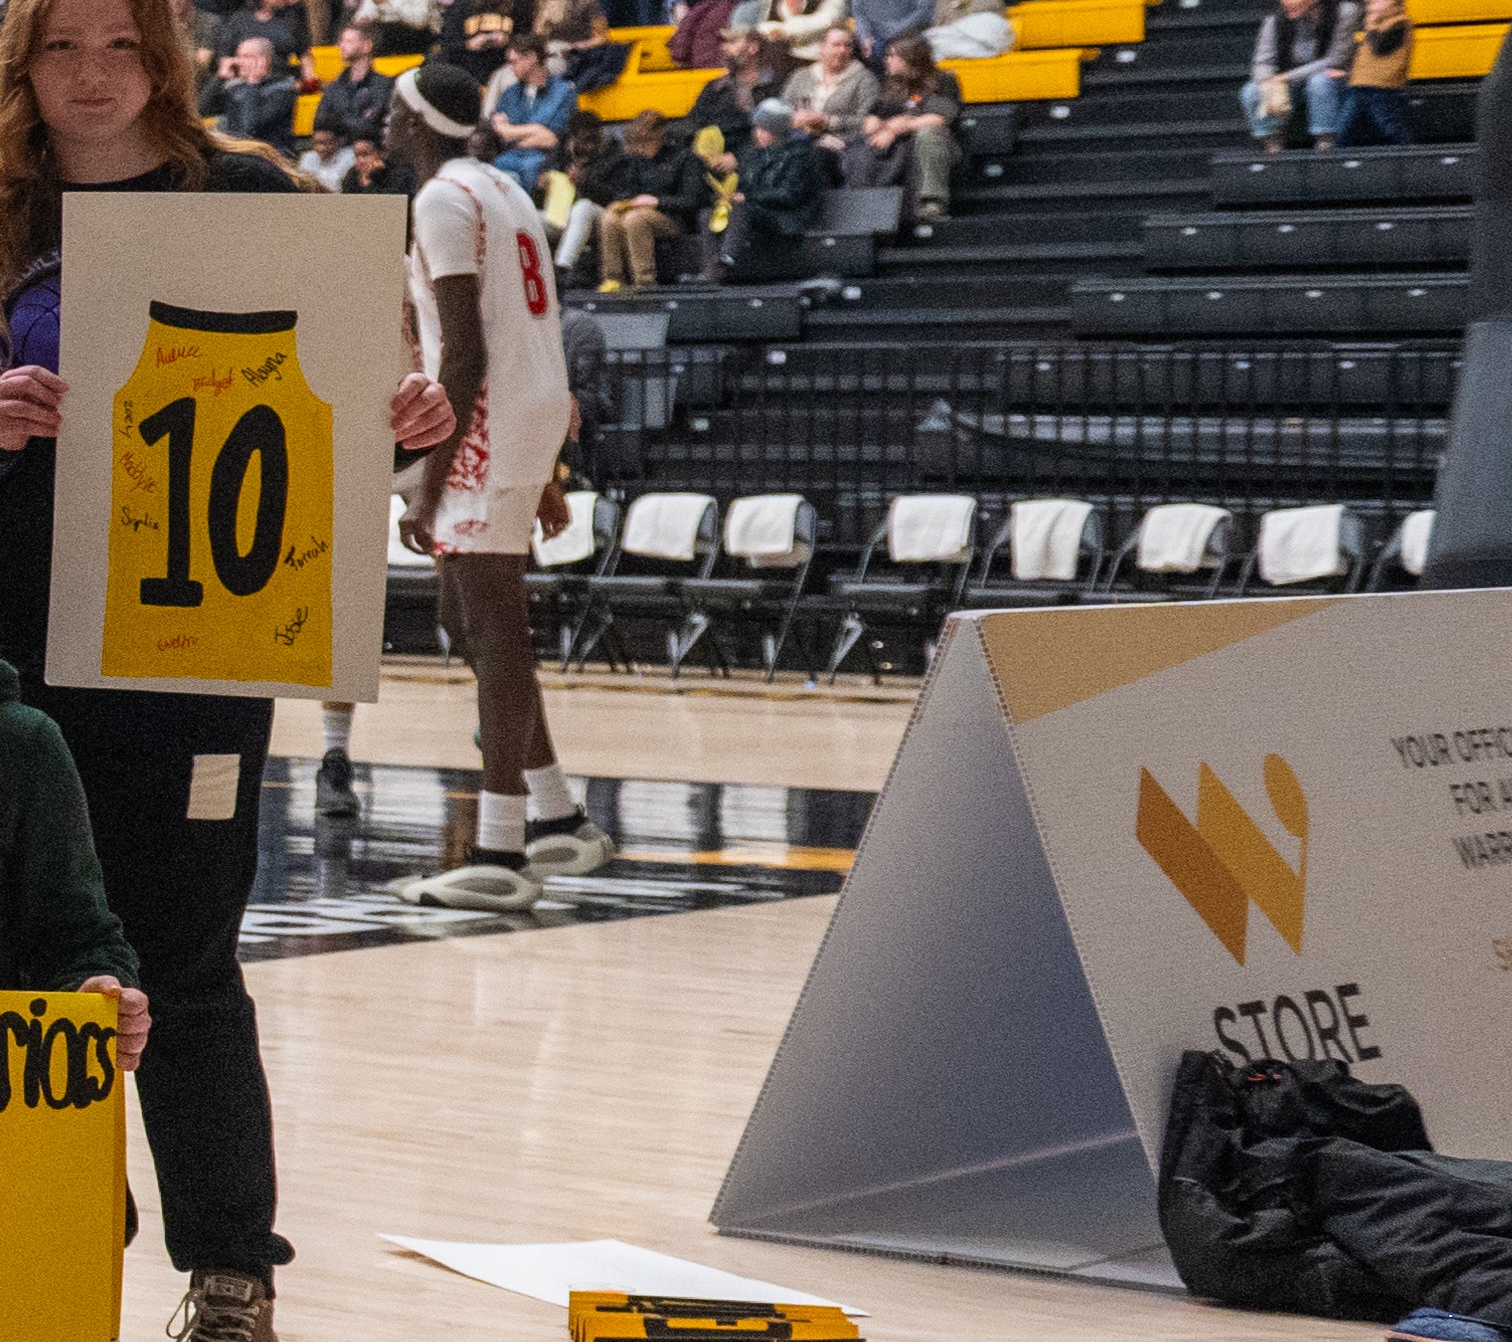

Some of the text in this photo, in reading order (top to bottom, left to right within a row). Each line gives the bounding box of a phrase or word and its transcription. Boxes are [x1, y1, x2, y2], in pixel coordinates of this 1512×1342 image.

[515, 231, 550, 317] 8
[138, 396, 289, 608] 10
[1390, 732, 1453, 769] YOUR
[1449, 780, 1495, 816] FOR
[1213, 982, 1383, 1065] STORE
